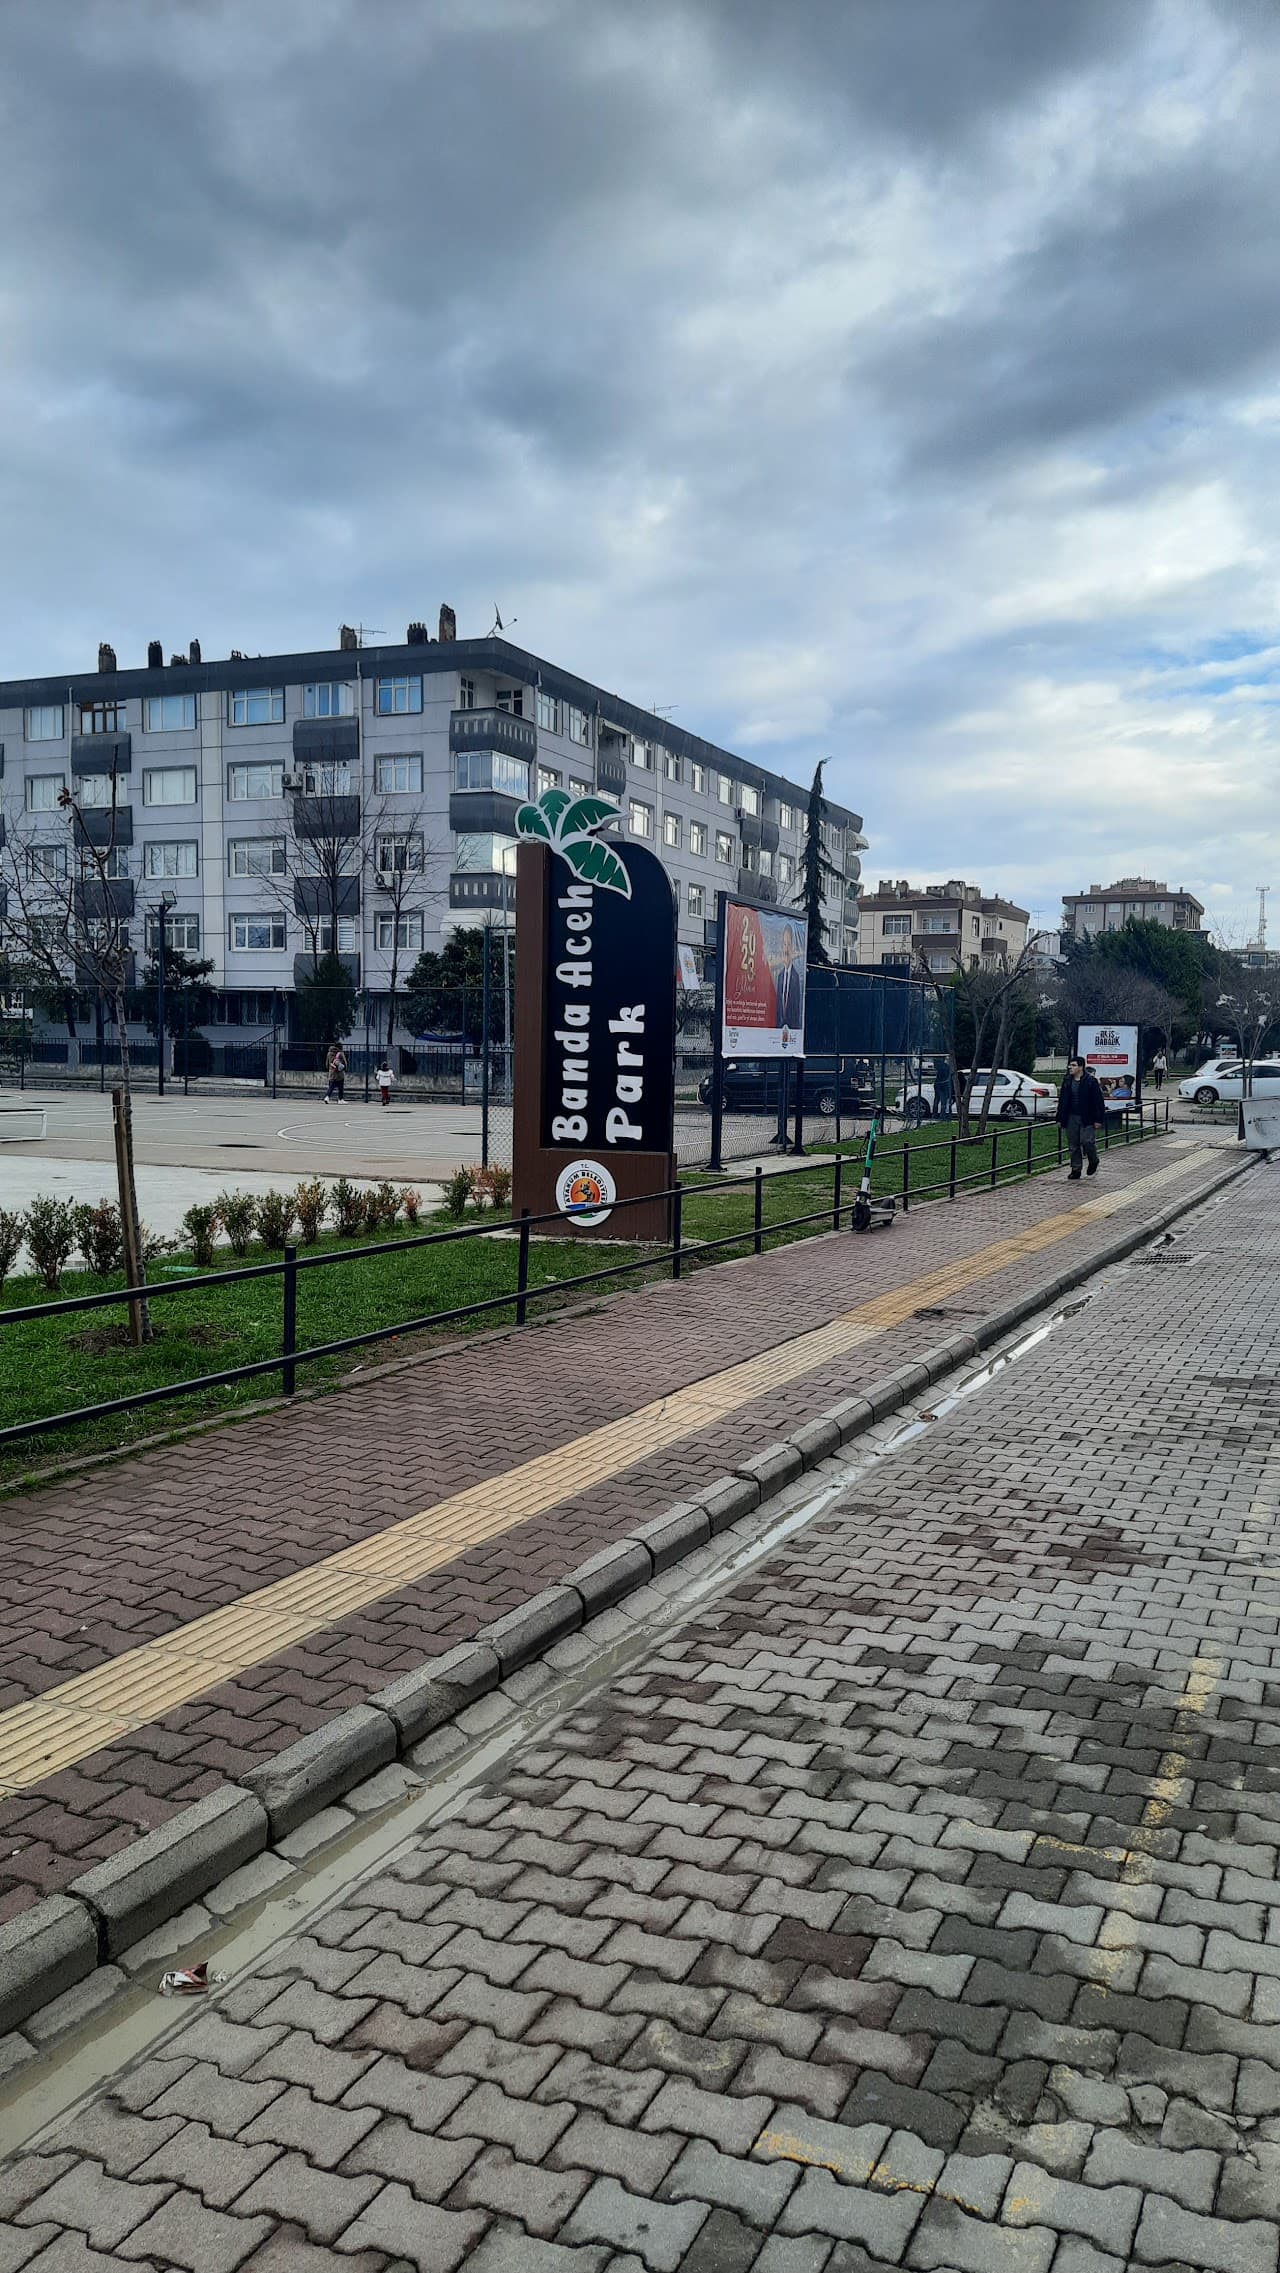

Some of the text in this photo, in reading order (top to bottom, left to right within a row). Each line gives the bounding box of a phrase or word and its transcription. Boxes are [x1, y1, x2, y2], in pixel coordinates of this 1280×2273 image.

[552, 885, 593, 1143] Banda Aceh
[606, 1004, 645, 1144] Park
